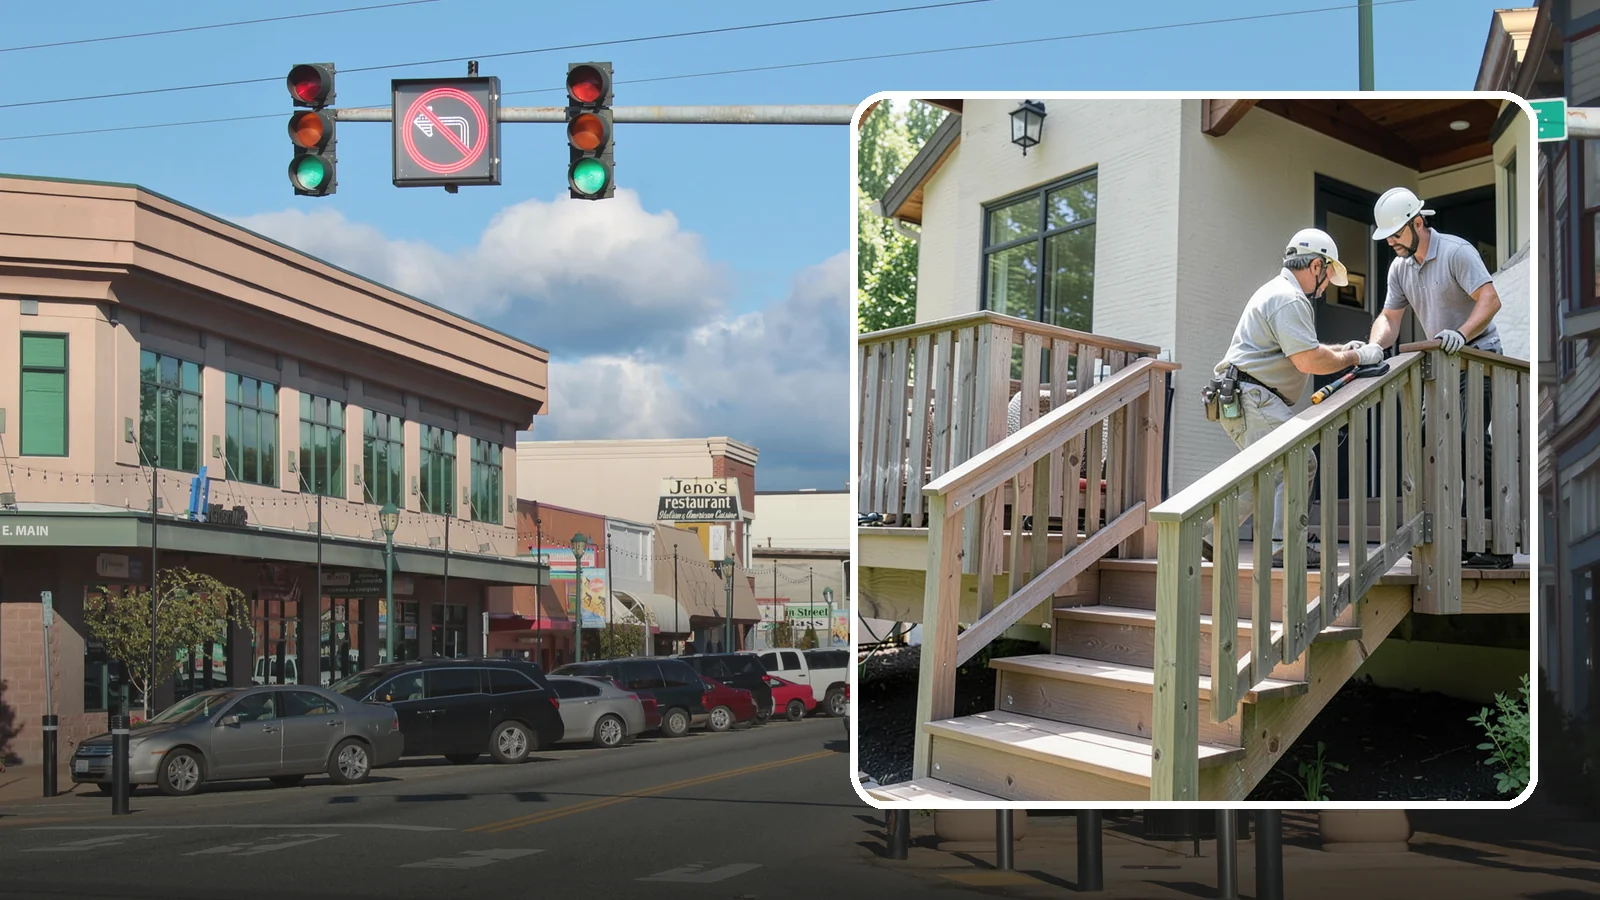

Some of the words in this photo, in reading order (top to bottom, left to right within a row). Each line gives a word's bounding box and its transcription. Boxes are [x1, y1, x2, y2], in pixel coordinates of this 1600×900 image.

[669, 480, 728, 494] Jeno's
[665, 496, 731, 509] restaurant
[658, 509, 681, 519] Italian
[686, 509, 714, 519] American
[715, 509, 738, 519] Cuisine
[2, 525, 13, 536] E.
[15, 525, 49, 536] MAIN
[797, 607, 828, 617] Street
[791, 619, 824, 627] lass
